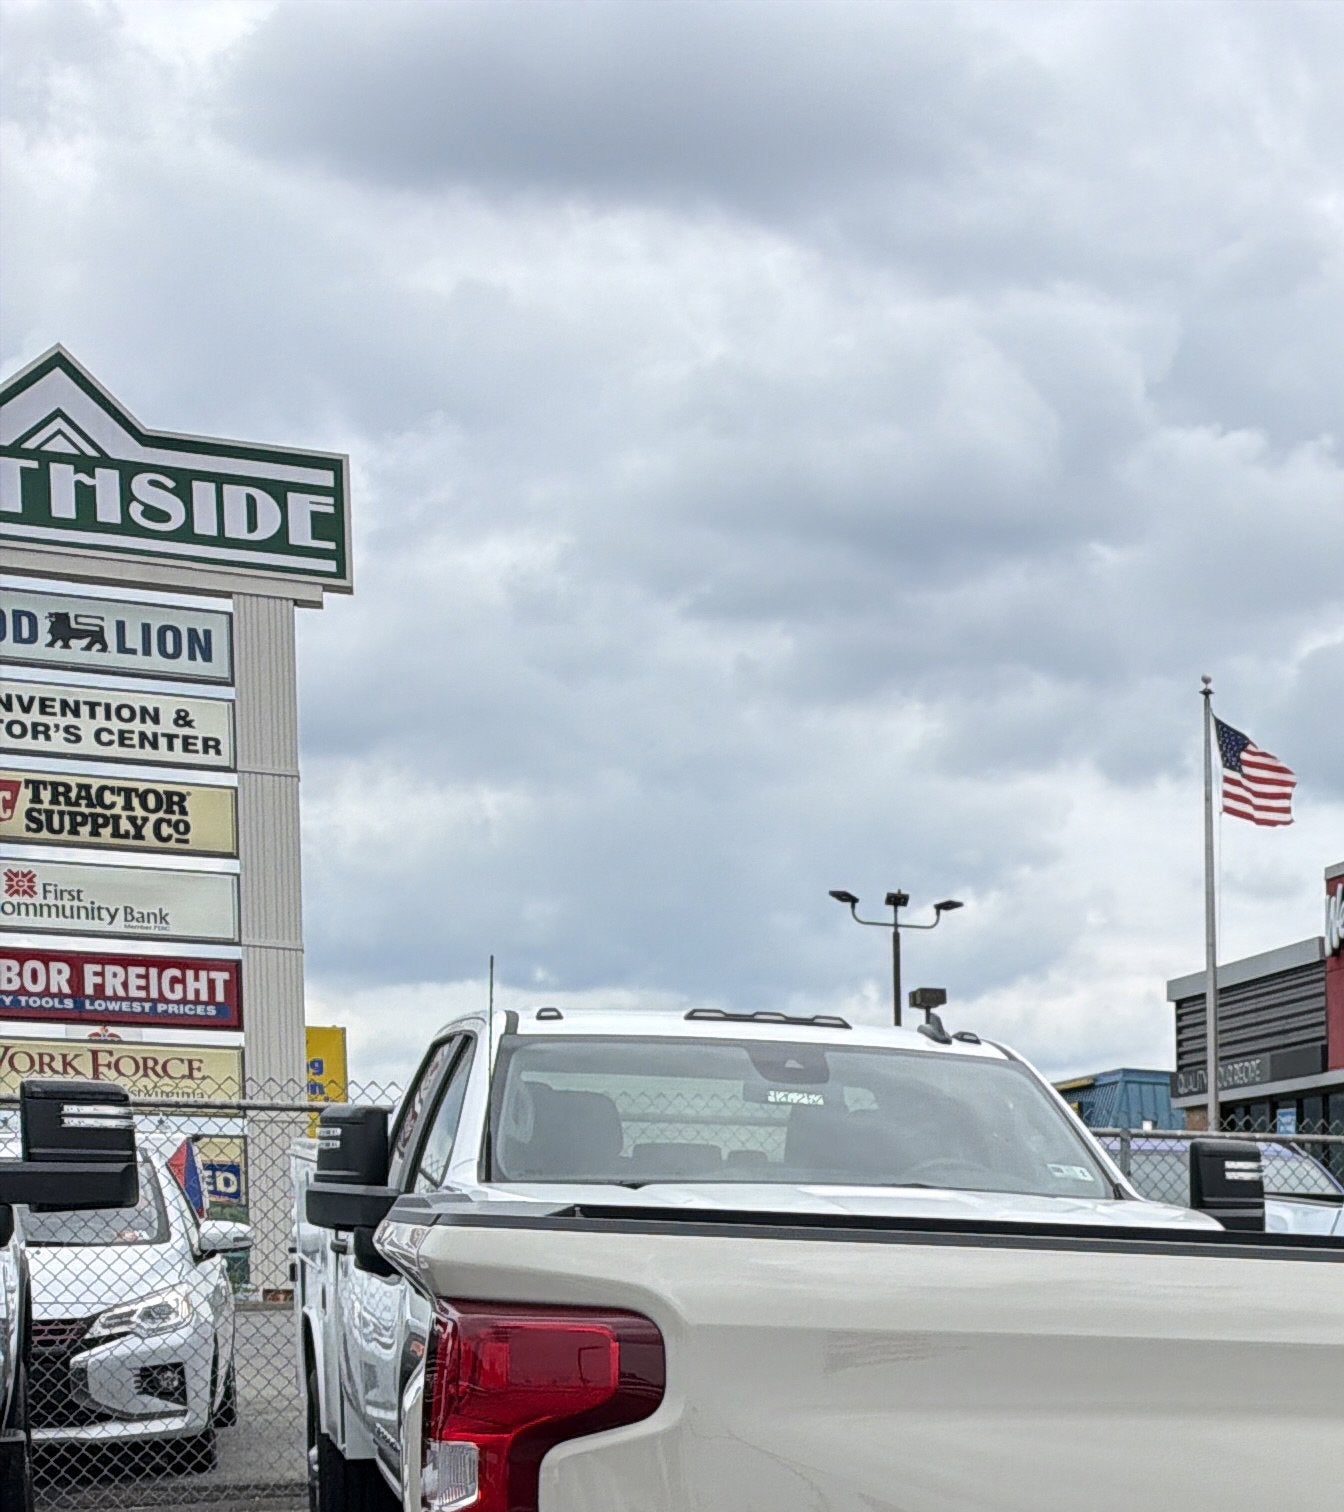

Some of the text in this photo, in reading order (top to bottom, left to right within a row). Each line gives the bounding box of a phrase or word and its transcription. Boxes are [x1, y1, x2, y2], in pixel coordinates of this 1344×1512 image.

[116, 620, 213, 663] LION
[173, 708, 195, 729] &
[0, 718, 222, 756] OR'S CENTER
[24, 779, 189, 816] TRACTOR
[25, 807, 149, 841] SUPPLY
[42, 882, 84, 902] First
[124, 905, 169, 925] Bank
[0, 959, 230, 1003] BOR FREIGHT
[17, 996, 74, 1009] TOOLS
[85, 999, 152, 1012] LOWEST
[157, 1003, 217, 1016] PRICES
[87, 1048, 208, 1081] FORCE
